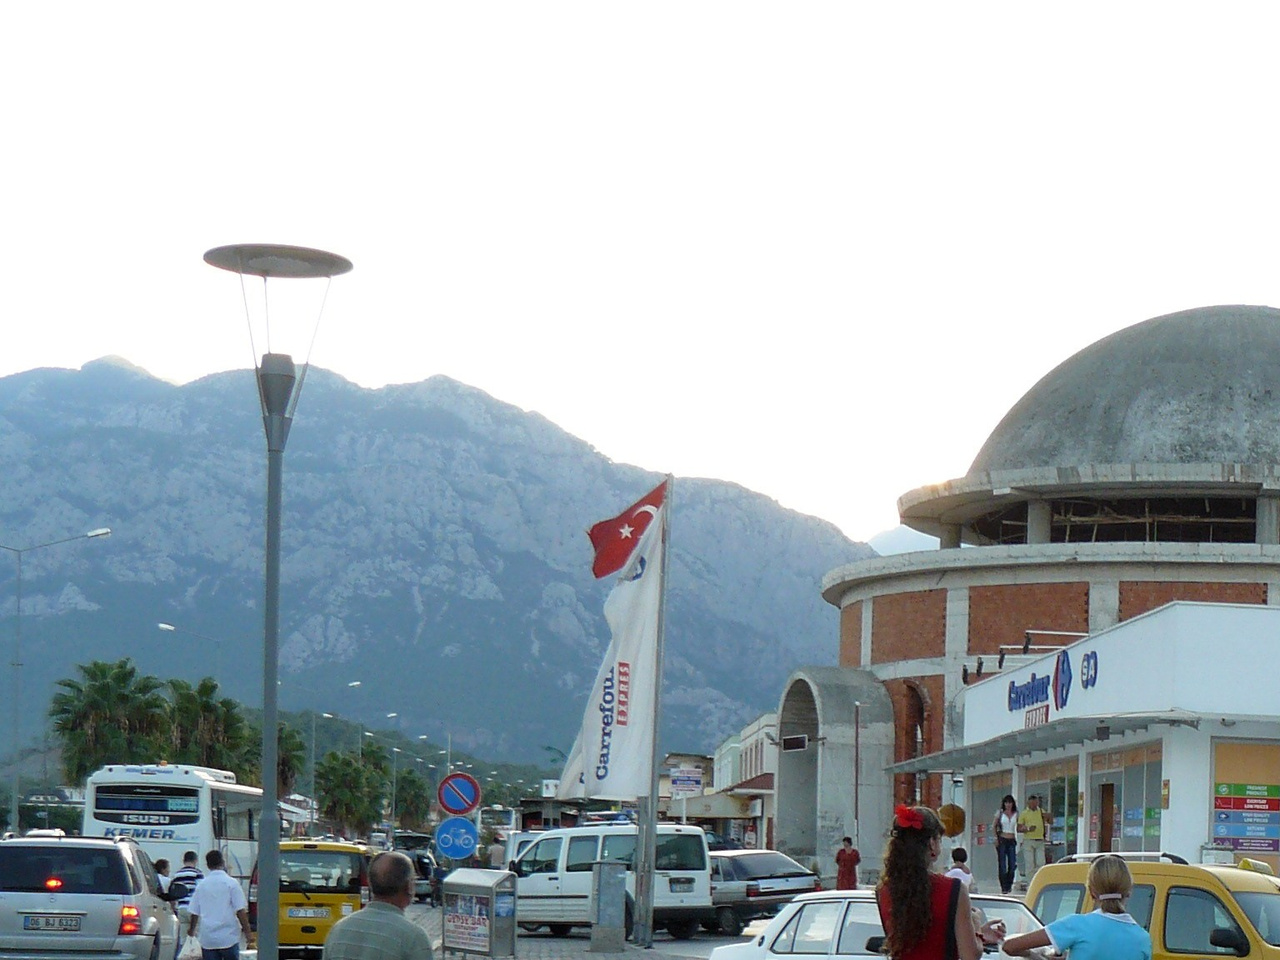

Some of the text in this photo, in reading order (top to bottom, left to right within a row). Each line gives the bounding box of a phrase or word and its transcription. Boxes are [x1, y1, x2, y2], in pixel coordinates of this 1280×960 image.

[617, 665, 630, 722] EXPRES
[595, 666, 615, 781] Carrefou
[104, 827, 176, 840] KEMER
[123, 814, 170, 824] ISUZU
